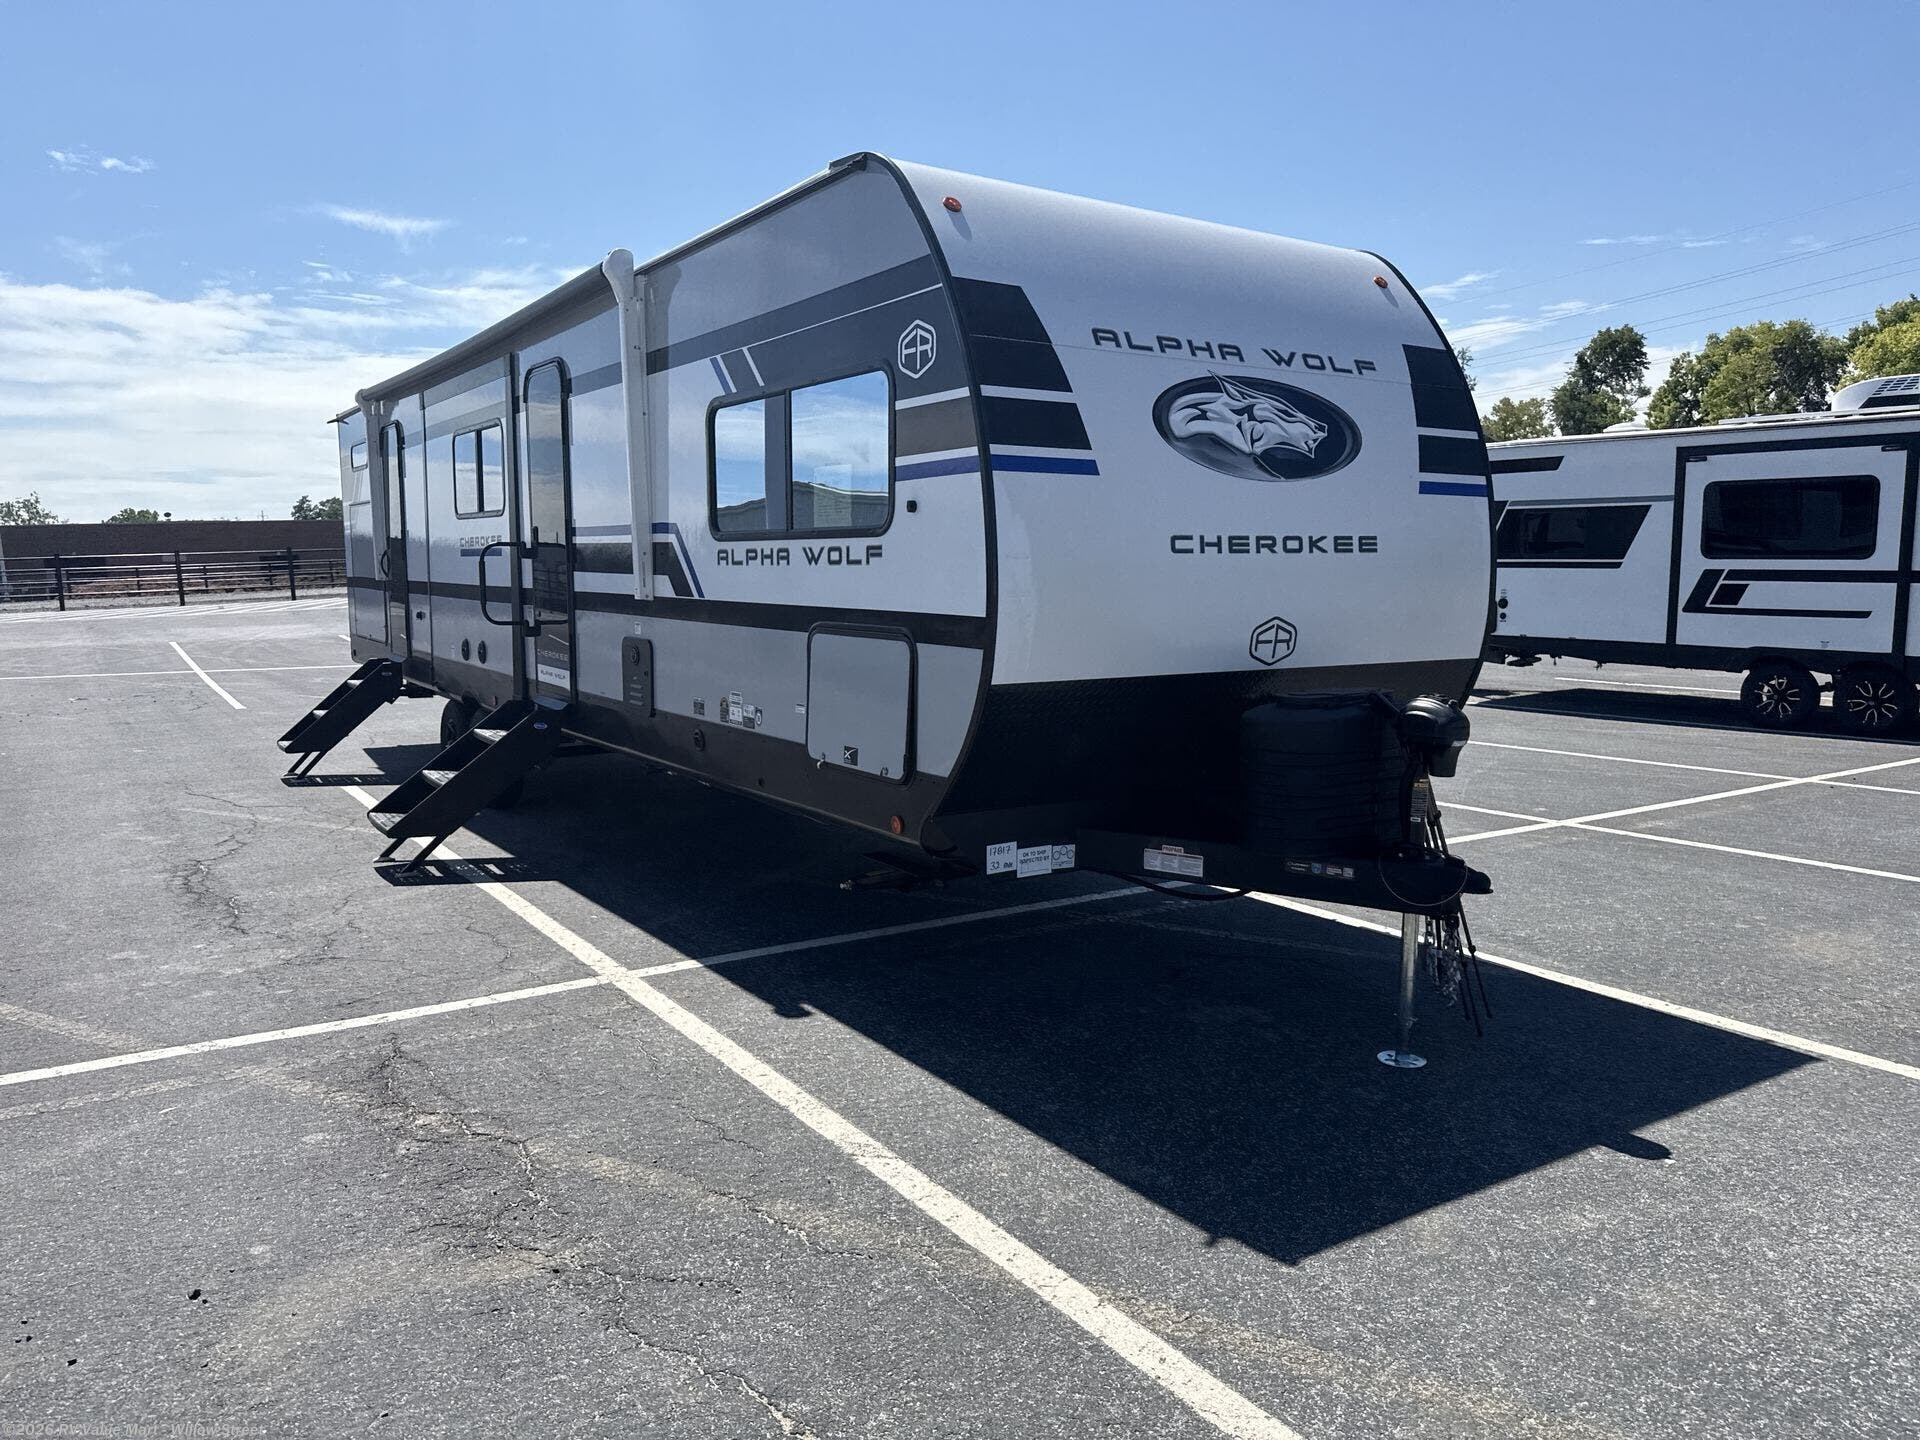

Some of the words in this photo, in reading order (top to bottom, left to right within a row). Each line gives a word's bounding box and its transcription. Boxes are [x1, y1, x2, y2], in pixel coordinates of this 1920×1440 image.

[1092, 327, 1245, 362] ALPHA
[1262, 348, 1377, 375] WOLF
[460, 535, 502, 547] CHEROKEE
[1170, 534, 1379, 554] CHEROKEE
[717, 548, 791, 566] ALPHA
[802, 544, 883, 565] WOLF
